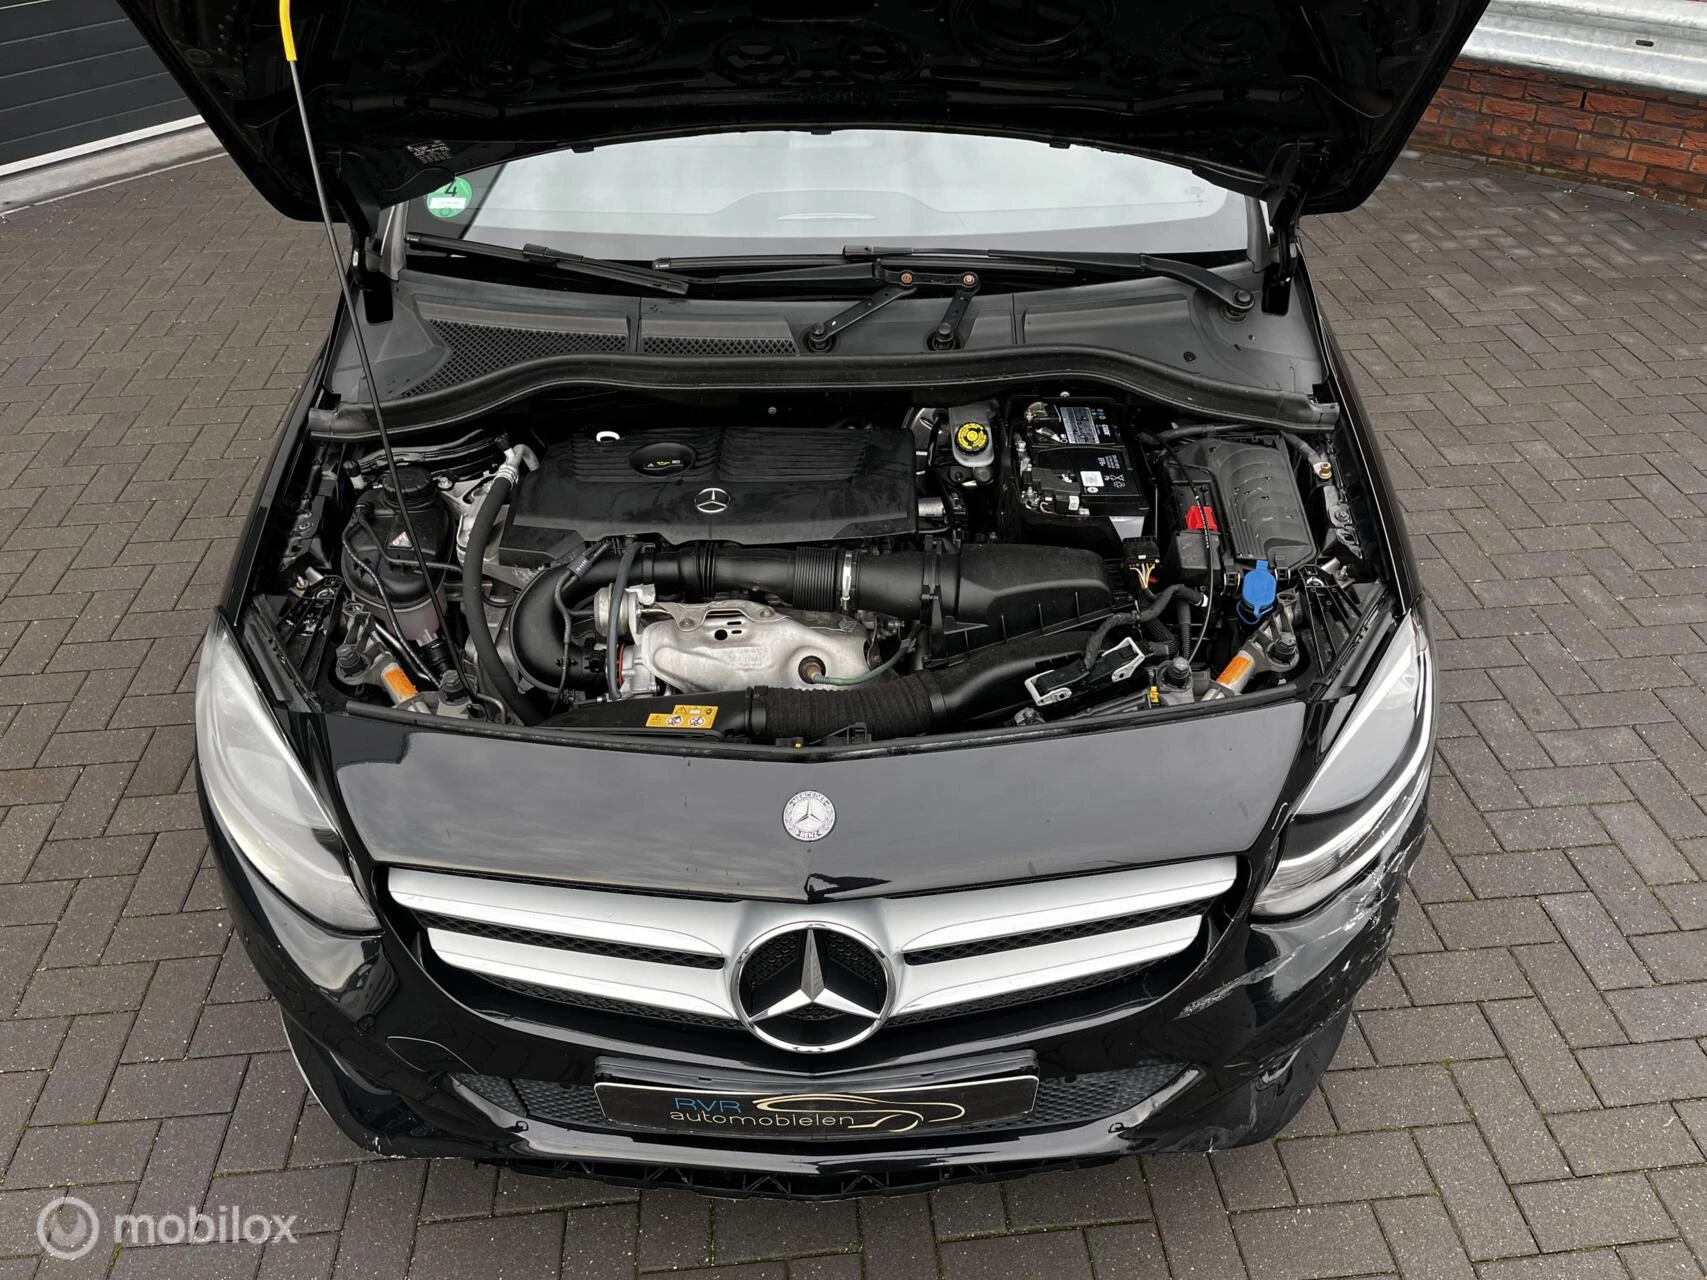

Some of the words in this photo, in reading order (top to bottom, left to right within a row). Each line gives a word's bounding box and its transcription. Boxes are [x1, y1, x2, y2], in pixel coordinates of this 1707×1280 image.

[444, 180, 457, 197] 4
[674, 1097, 741, 1113] RVR
[669, 1111, 854, 1127] automobielen
